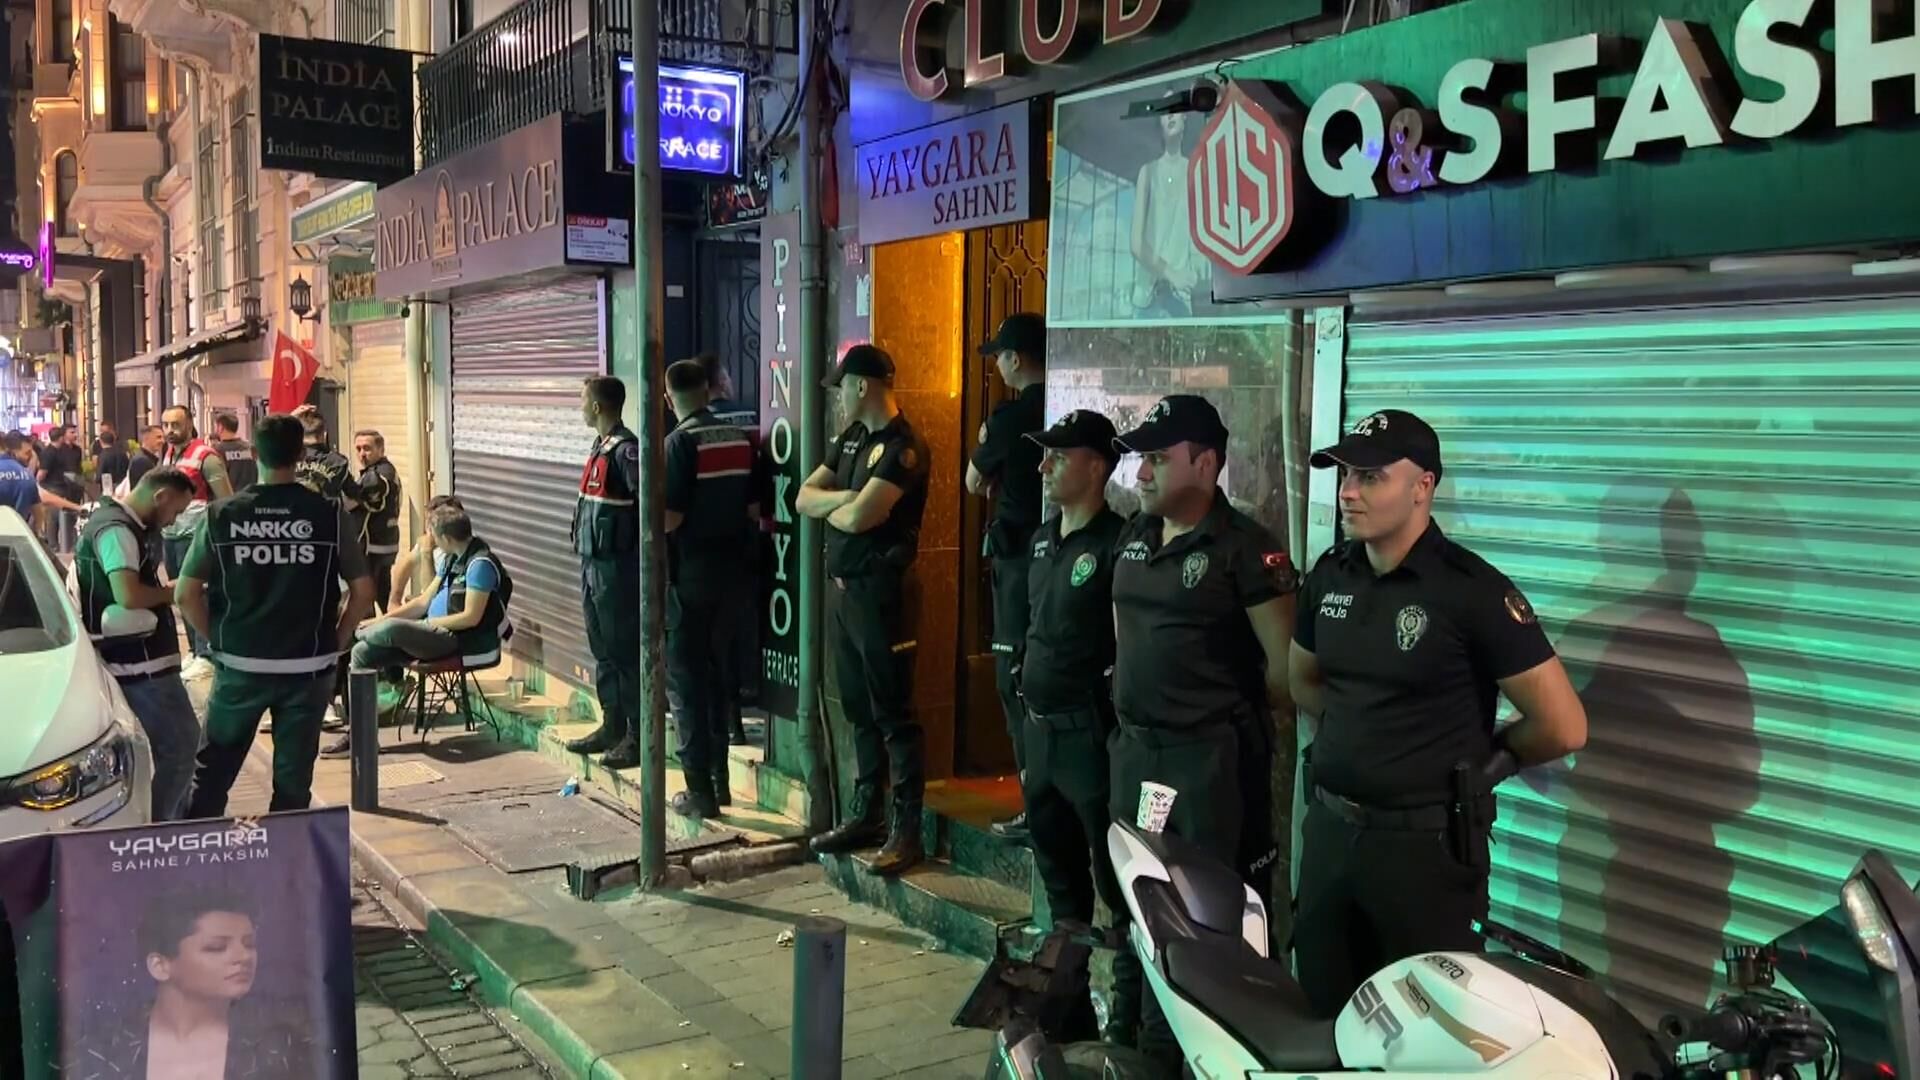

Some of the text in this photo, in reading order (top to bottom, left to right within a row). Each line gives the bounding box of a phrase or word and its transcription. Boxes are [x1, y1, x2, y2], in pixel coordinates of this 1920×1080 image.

[271, 92, 402, 130] PALACE
[1303, 60, 1502, 199] Q&S
[867, 122, 1017, 200] YAYGARA
[460, 159, 558, 249] PALACE
[933, 178, 1017, 225] SAHNE
[234, 544, 315, 565] POLİS
[109, 827, 268, 857] YAYGARA
[112, 855, 178, 872] SAHNE
